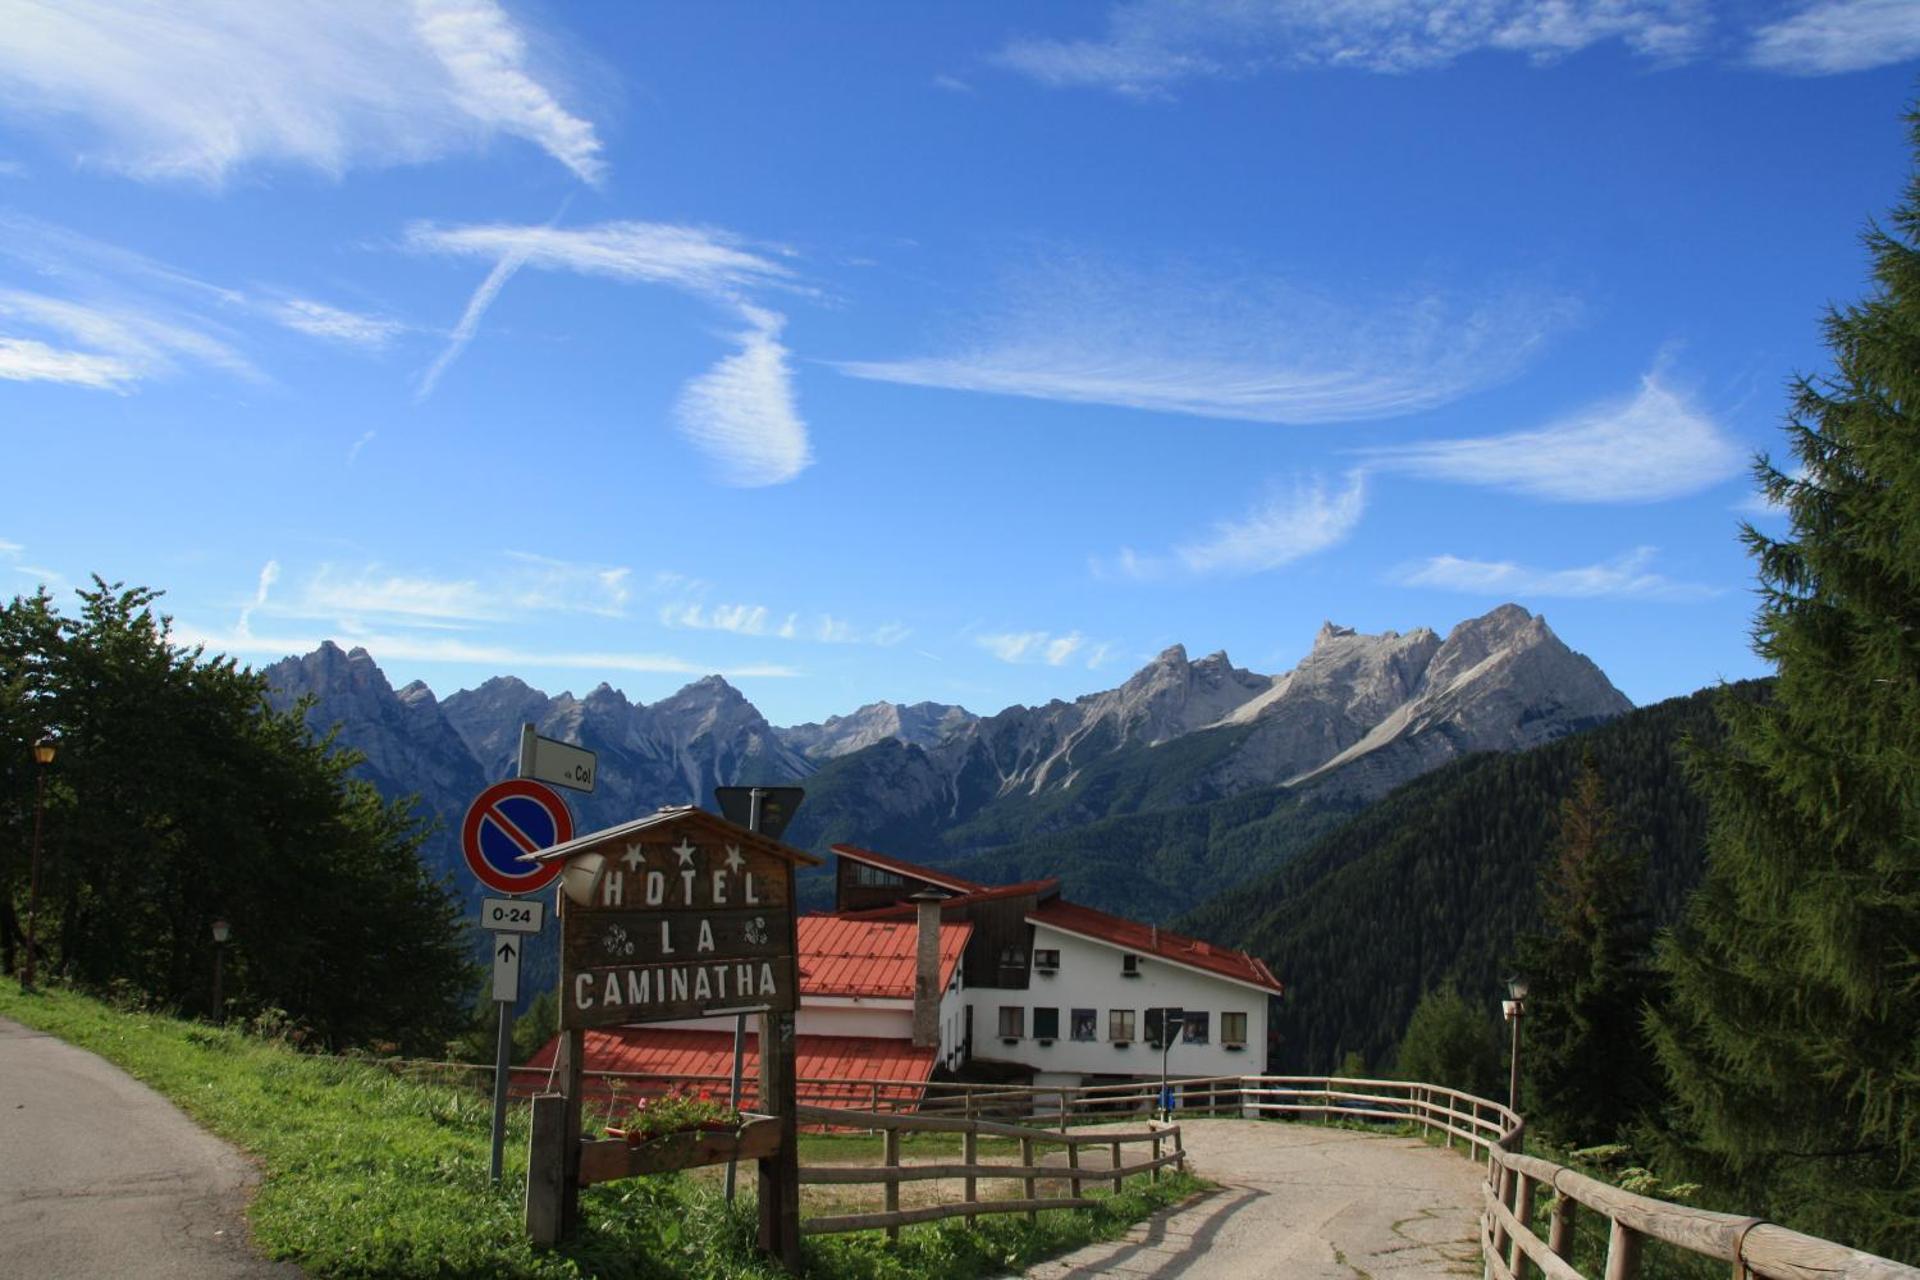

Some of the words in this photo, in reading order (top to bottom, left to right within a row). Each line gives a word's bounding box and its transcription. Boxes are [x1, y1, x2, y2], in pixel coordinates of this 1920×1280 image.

[575, 765, 591, 785] Col
[603, 870, 759, 906] HOTEL
[493, 907, 531, 923] 0-24
[661, 919, 715, 953] LA
[575, 963, 776, 1010] CAMINATHA
